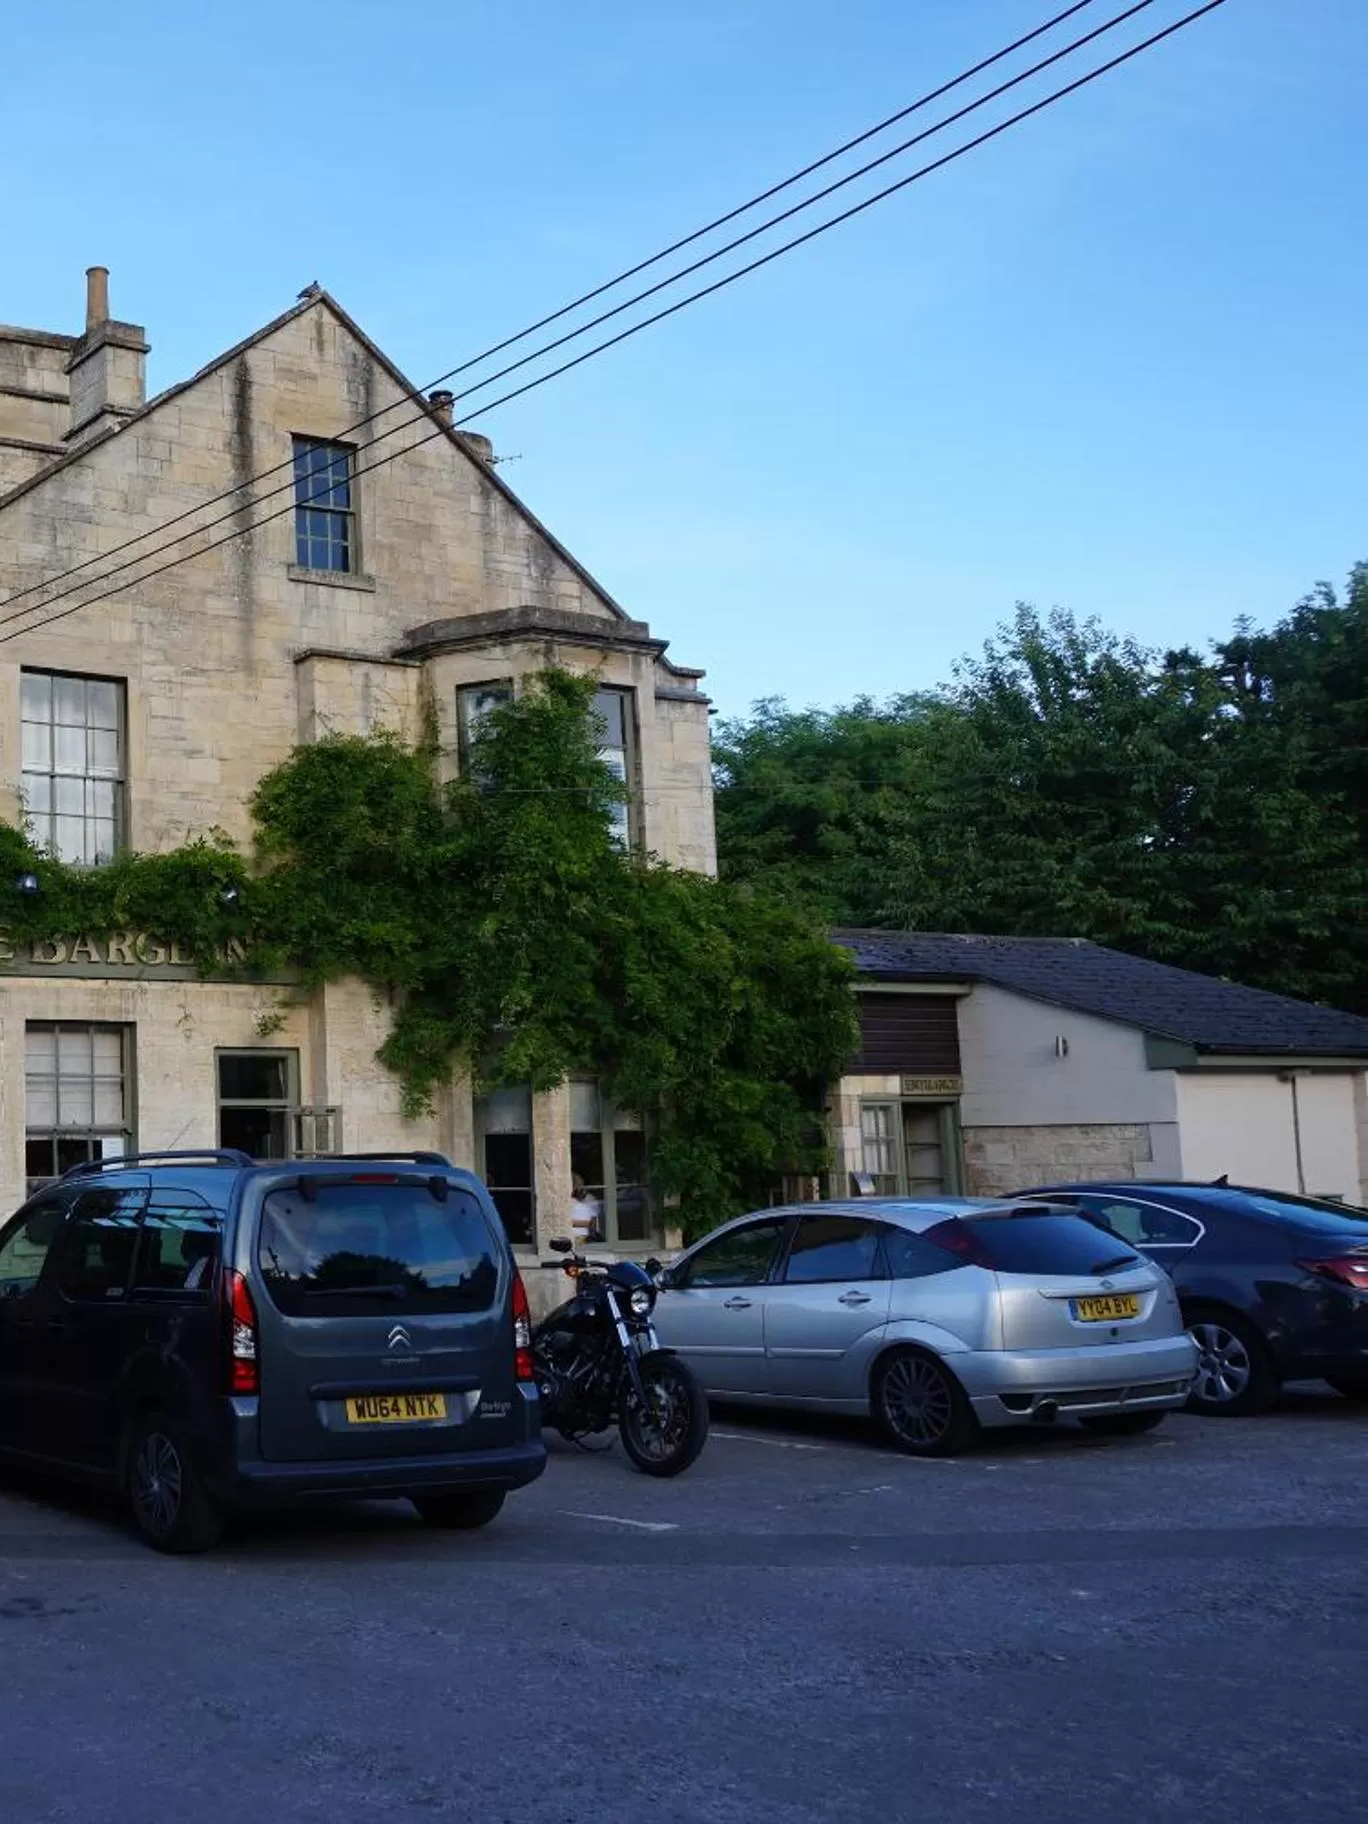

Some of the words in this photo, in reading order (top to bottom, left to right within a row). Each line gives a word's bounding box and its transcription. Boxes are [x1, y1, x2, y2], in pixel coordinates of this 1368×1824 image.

[28, 930, 194, 965] BARGE
[355, 1398, 402, 1420] WU64
[406, 1396, 439, 1417] NTK
